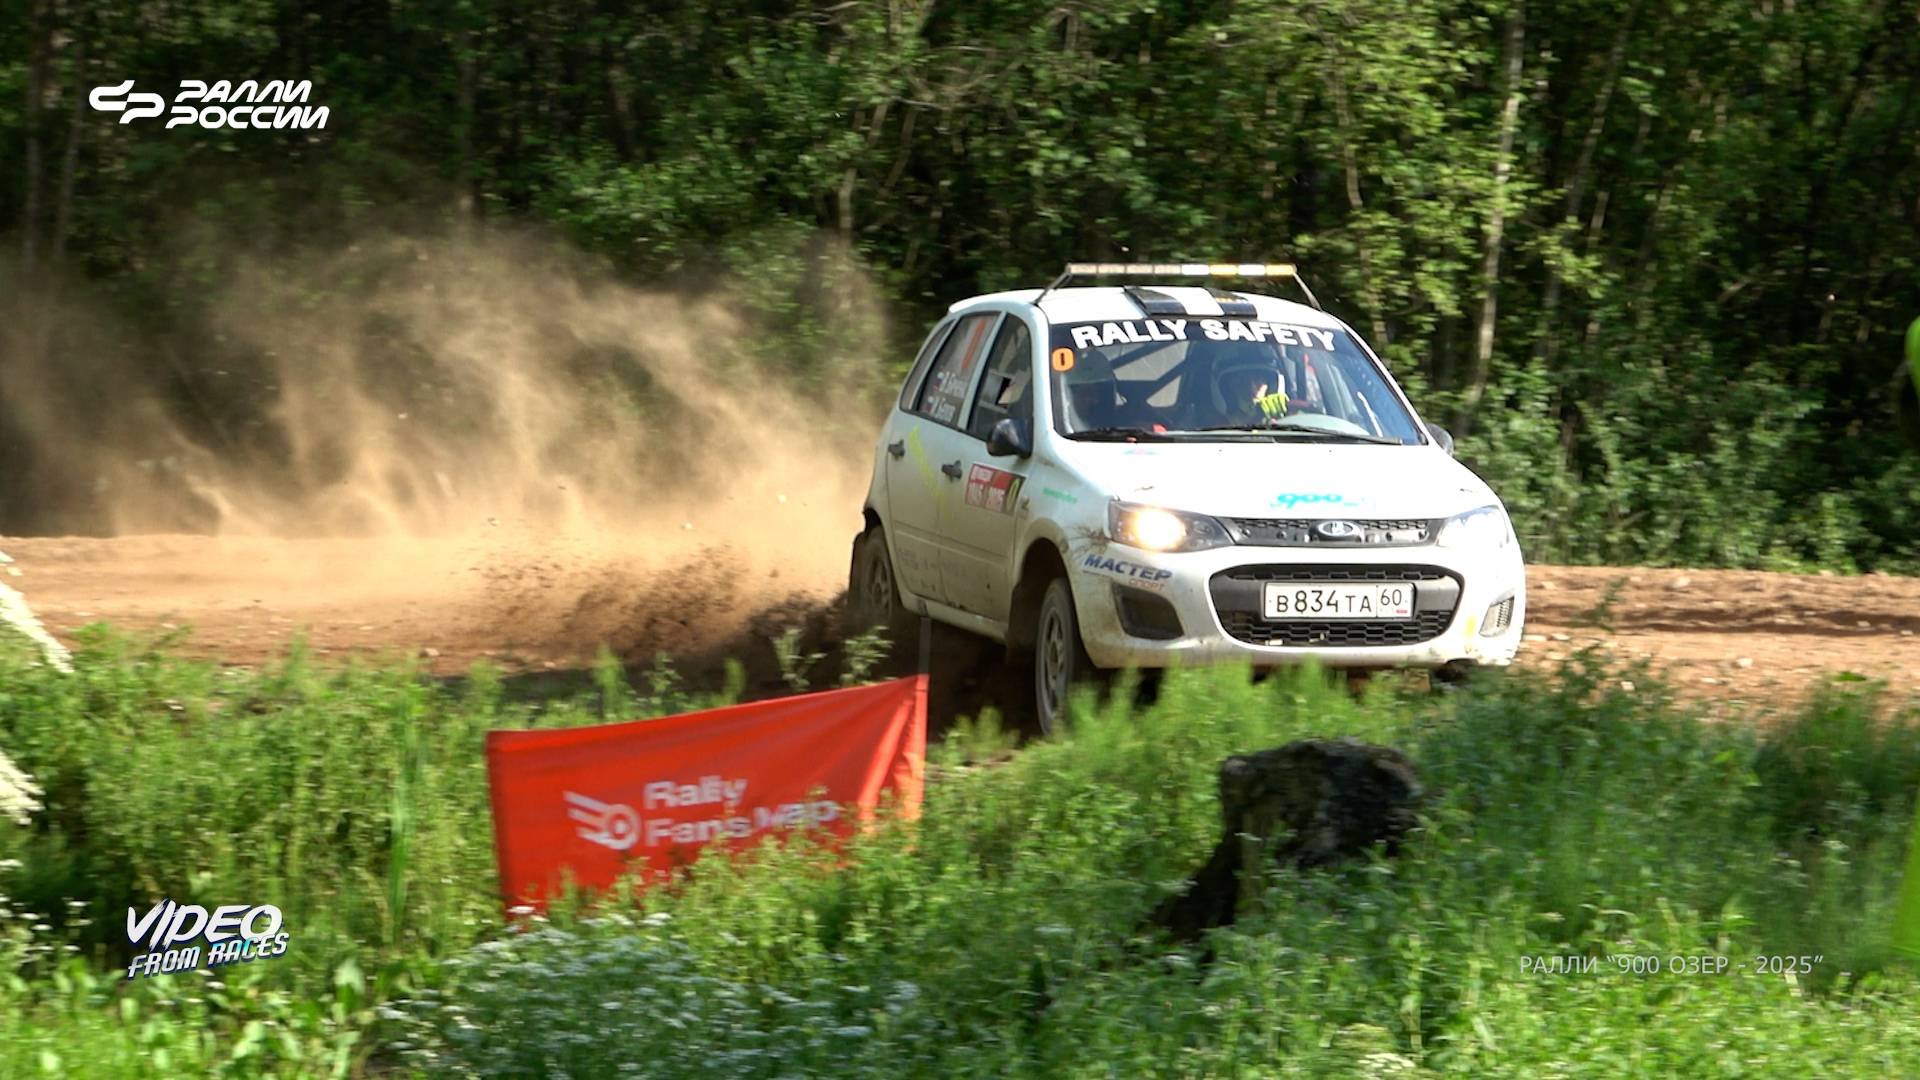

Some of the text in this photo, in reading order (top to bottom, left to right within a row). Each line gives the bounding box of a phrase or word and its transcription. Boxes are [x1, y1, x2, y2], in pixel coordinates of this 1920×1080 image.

[1071, 319, 1336, 351] RALLY SAFETY
[1084, 553, 1173, 581] МАСТЕР
[1380, 588, 1402, 606] 60
[643, 775, 748, 810] Rally
